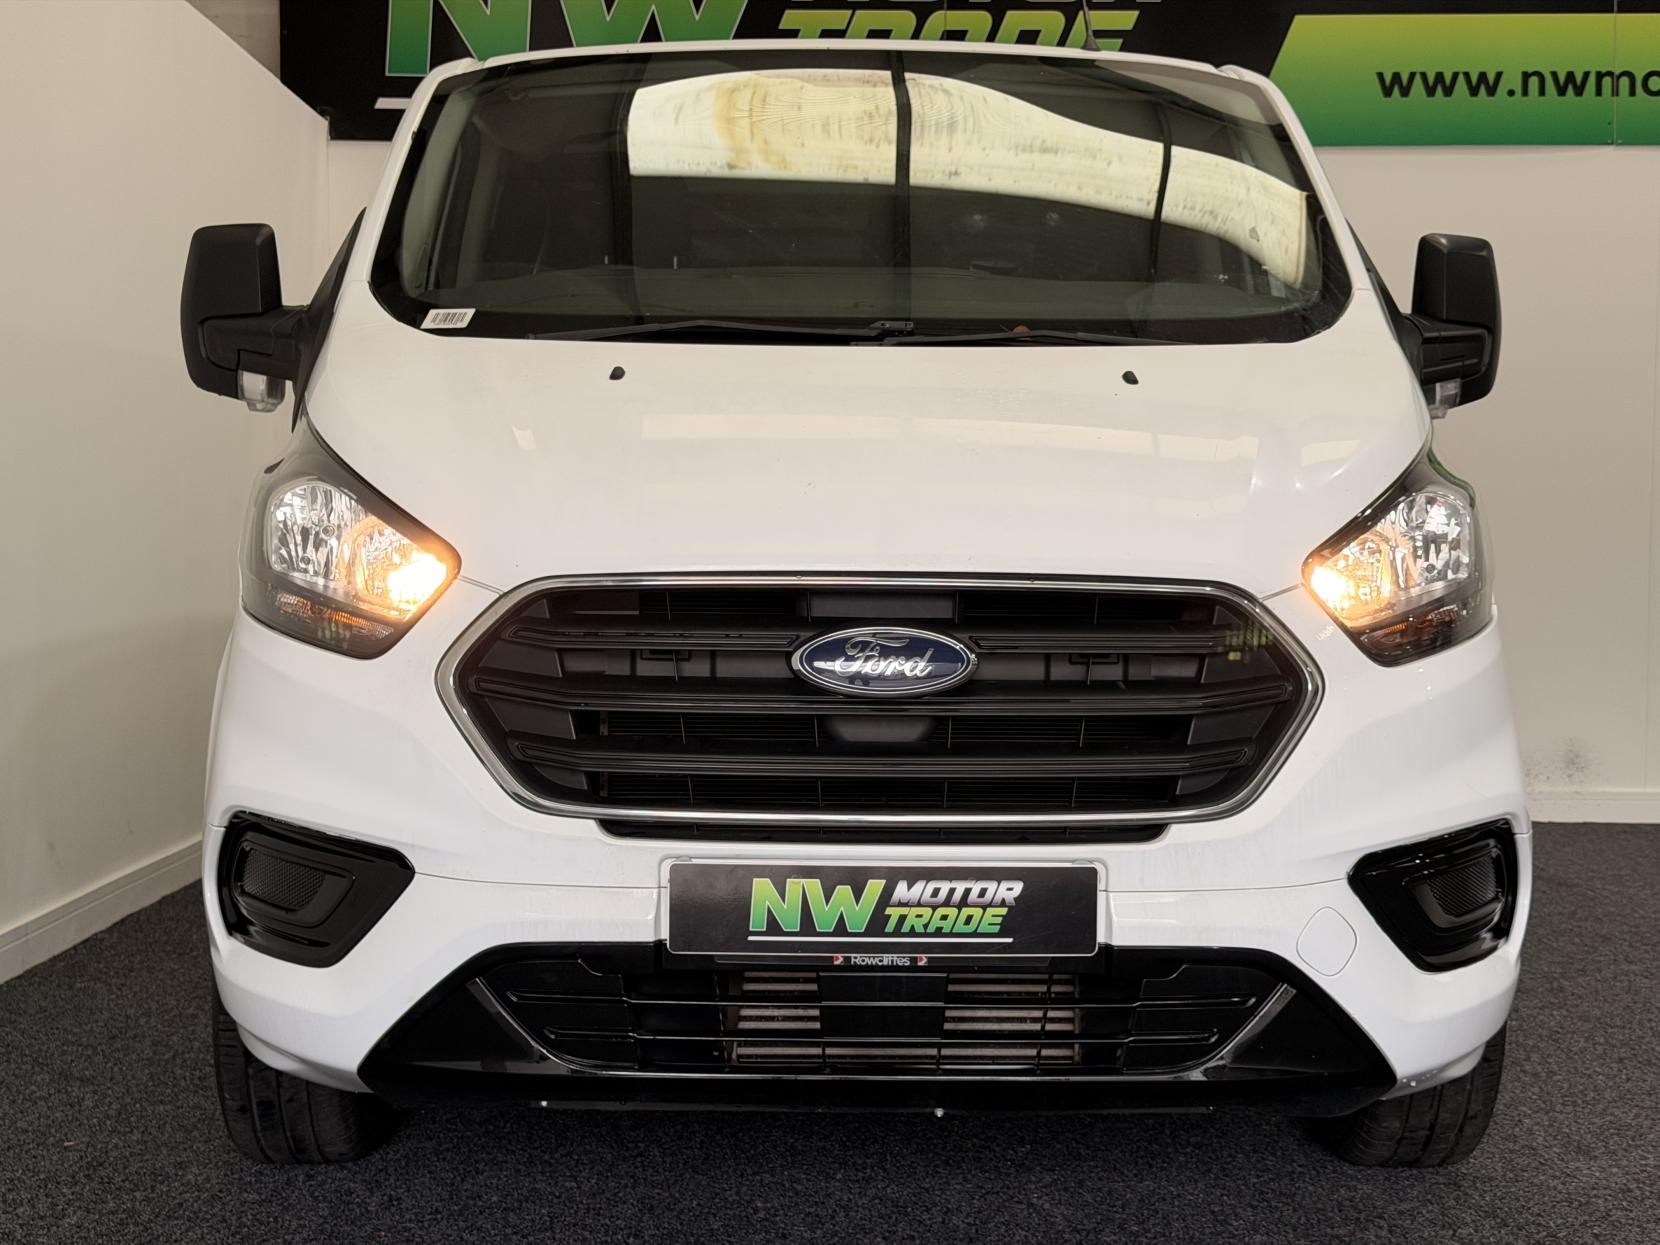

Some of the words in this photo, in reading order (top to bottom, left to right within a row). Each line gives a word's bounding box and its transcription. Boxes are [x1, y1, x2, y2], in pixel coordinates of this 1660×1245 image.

[834, 636, 935, 677] Ford
[749, 878, 887, 932] NW
[889, 880, 1024, 906] MOTOR
[884, 907, 1009, 933] TRADE
[850, 955, 911, 966] Rowcliffes
